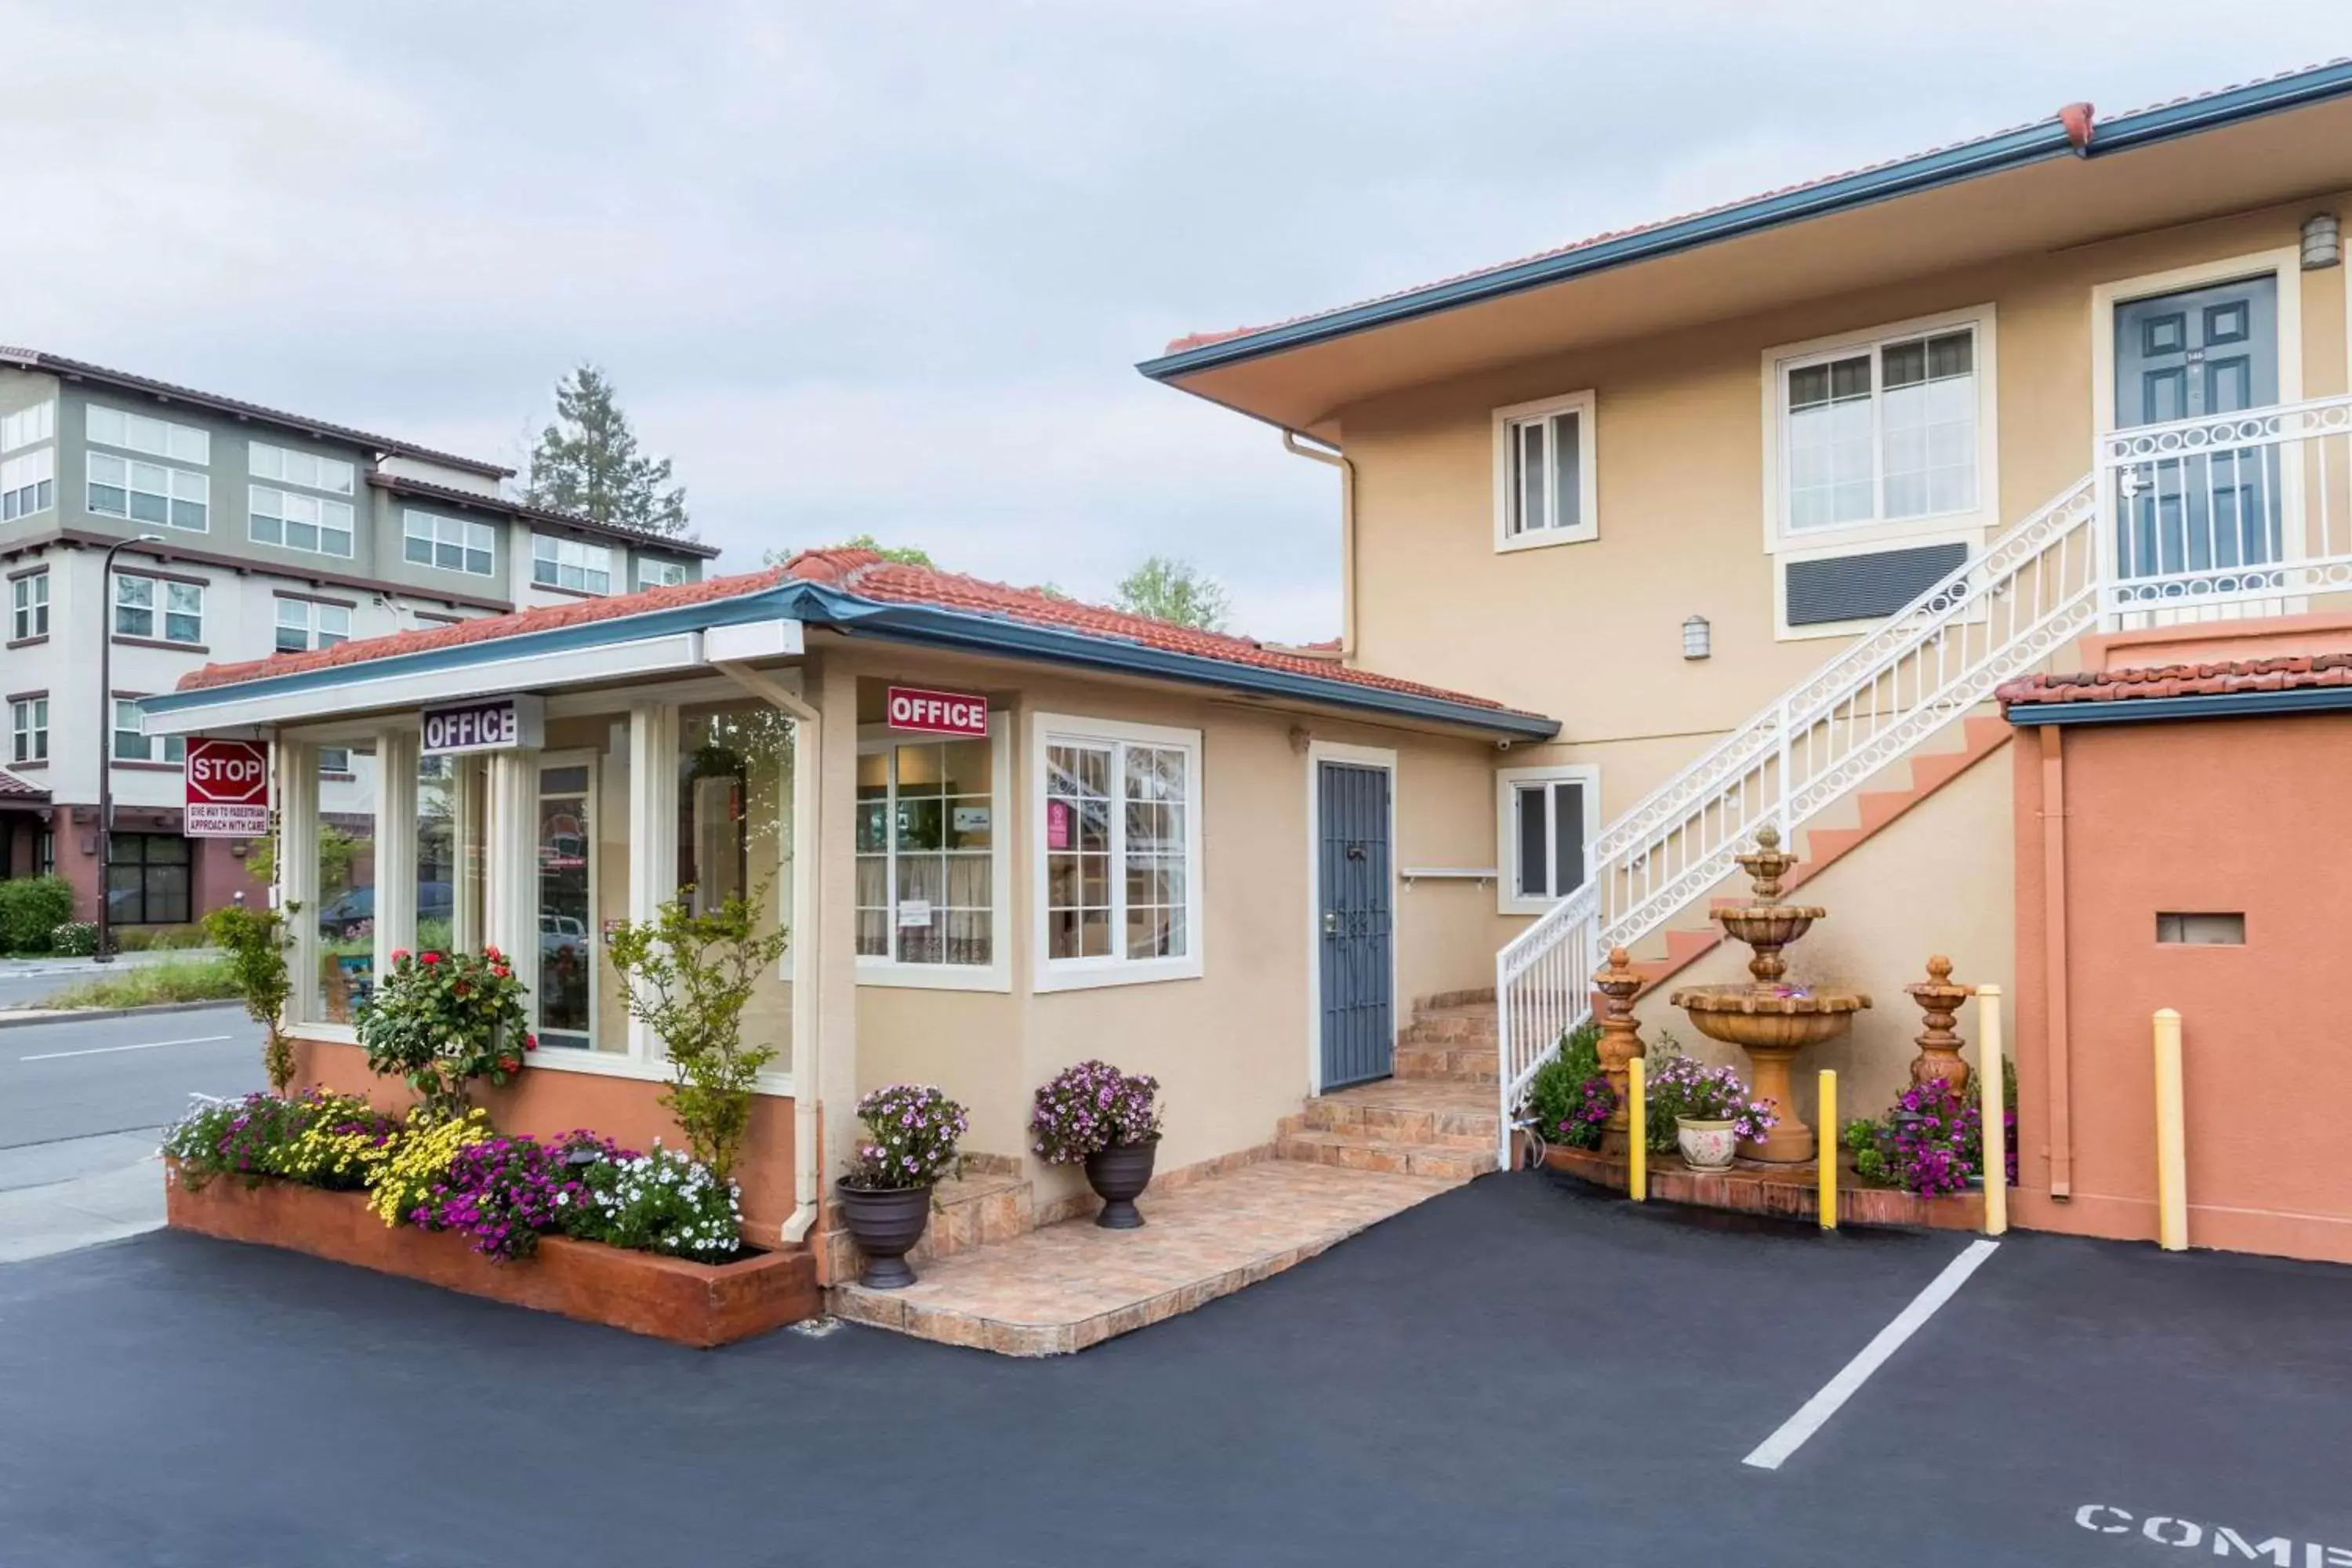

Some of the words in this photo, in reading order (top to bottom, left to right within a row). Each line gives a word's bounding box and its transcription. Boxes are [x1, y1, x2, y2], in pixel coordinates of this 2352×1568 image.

[892, 697, 984, 728] OFFICE
[427, 709, 517, 747] OFFICE
[194, 758, 260, 781] STOP
[207, 807, 219, 816] WAY
[220, 807, 228, 817] TO
[191, 819, 226, 830] APPROACH
[228, 821, 245, 831] WITH
[247, 820, 265, 832] CARE
